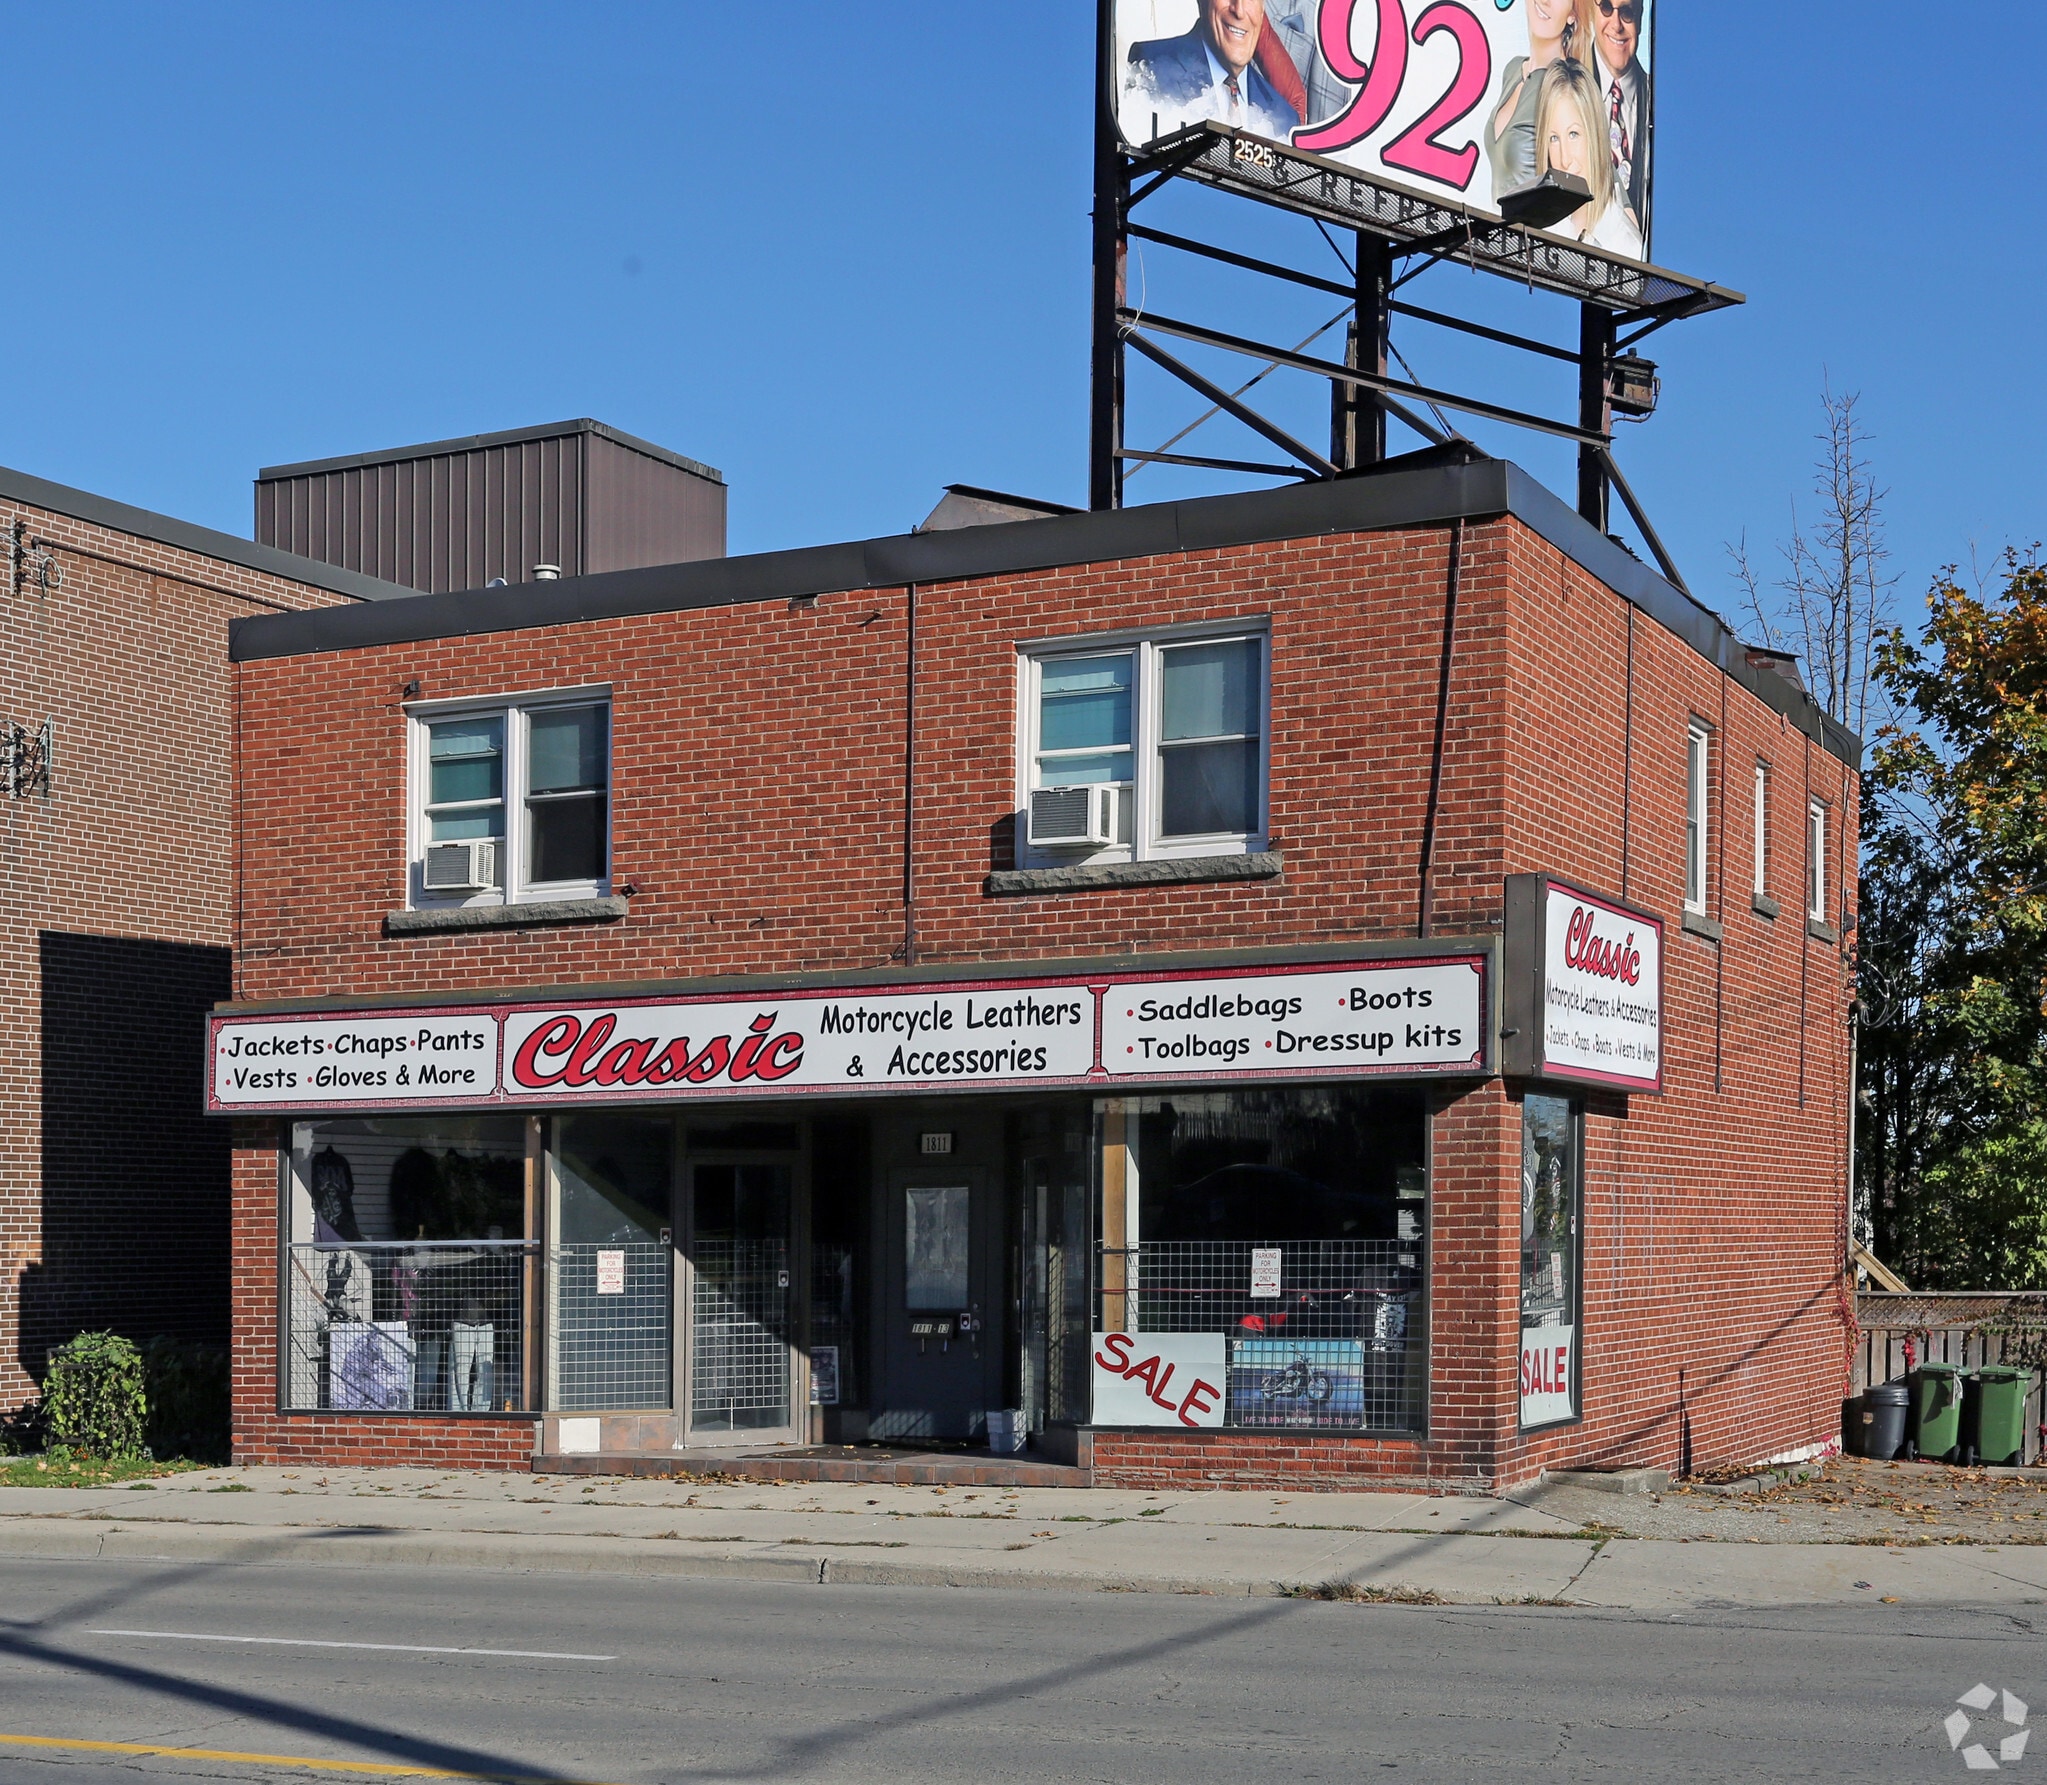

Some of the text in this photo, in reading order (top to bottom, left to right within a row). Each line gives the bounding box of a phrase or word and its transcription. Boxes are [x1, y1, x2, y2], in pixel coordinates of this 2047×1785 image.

[1291, 0, 1493, 190] 92
[1234, 138, 1274, 168] 2525
[1564, 905, 1640, 987] Classic
[820, 995, 1082, 1041] Motorcycle Leathers
[1137, 986, 1433, 1023] Saddlebags Boots
[1545, 978, 1657, 1028] Motorcycle Leathers & Accessories
[228, 1029, 485, 1059] Jackets Chaps Pants
[512, 1010, 805, 1088] Classic
[846, 1039, 1047, 1077] & Accessories
[1137, 1024, 1462, 1062] Toolbags Dressup kits
[1549, 1024, 1656, 1064] Jackets Chaps Boots Vests & More
[234, 1064, 476, 1089] Vests Gloves & More
[926, 1136, 947, 1152] 1811
[1095, 1333, 1221, 1427] SALE
[1521, 1346, 1567, 1396] SALE
